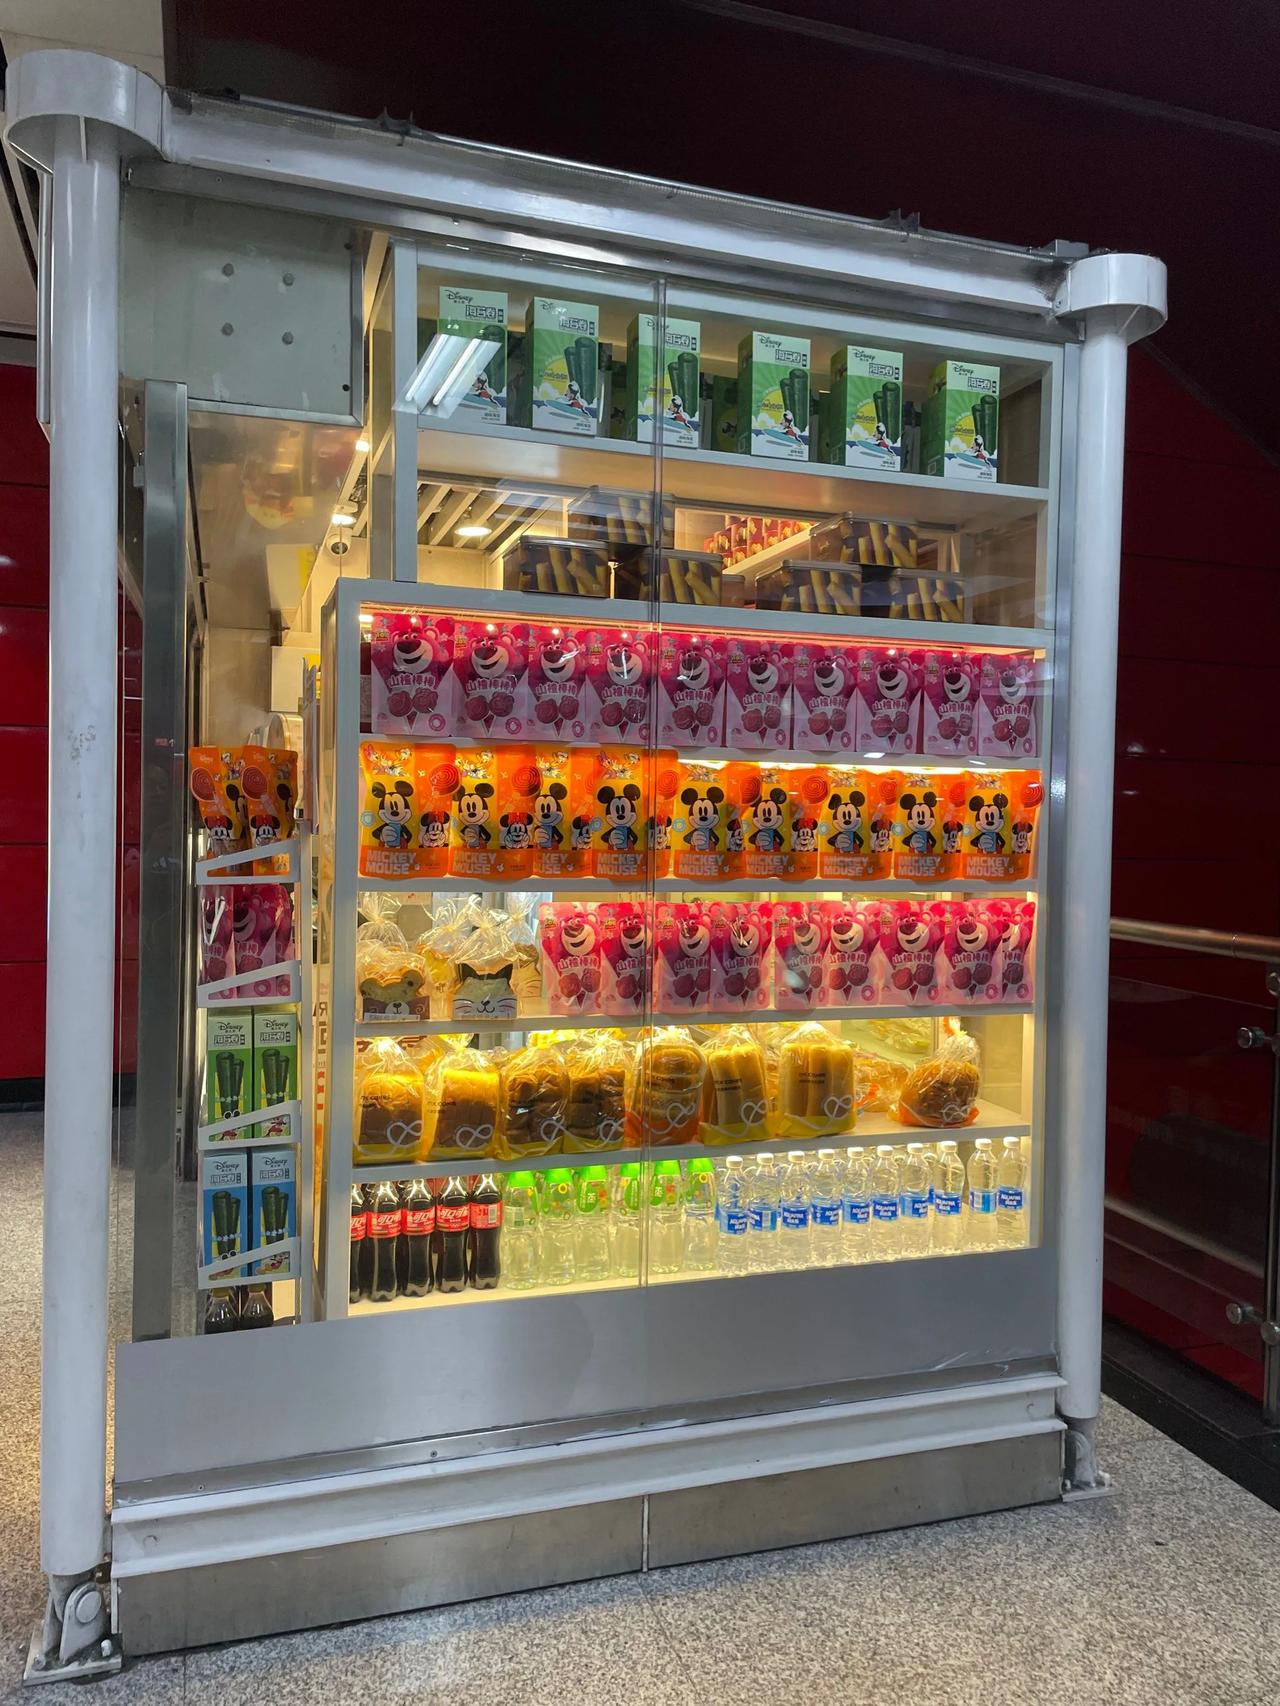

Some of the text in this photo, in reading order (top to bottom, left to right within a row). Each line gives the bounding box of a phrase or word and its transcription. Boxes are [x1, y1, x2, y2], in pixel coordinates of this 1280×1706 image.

[445, 289, 474, 303] Disney
[758, 335, 783, 348] Disney
[852, 349, 876, 361] Disney
[951, 364, 975, 376] Disney
[367, 850, 417, 865] MICKEY
[598, 853, 643, 865] MICKEY
[680, 854, 724, 866] MICKEY
[746, 854, 789, 866] MICKEY
[825, 855, 869, 867] MICKEY
[899, 855, 941, 867] MICKEY
[968, 856, 1010, 868] MICKEY
[365, 863, 410, 875] MOUSE
[597, 864, 639, 876] MOUSE
[678, 864, 719, 876] MOUSE
[745, 864, 785, 877] MOUSE
[823, 866, 865, 877] MOUSE
[898, 866, 936, 878] MOUSE
[966, 866, 1005, 878] MOUSE
[216, 1021, 244, 1033] Disney
[263, 1019, 289, 1031] Disney
[213, 1161, 241, 1173] Disney
[261, 1157, 289, 1168] Disney
